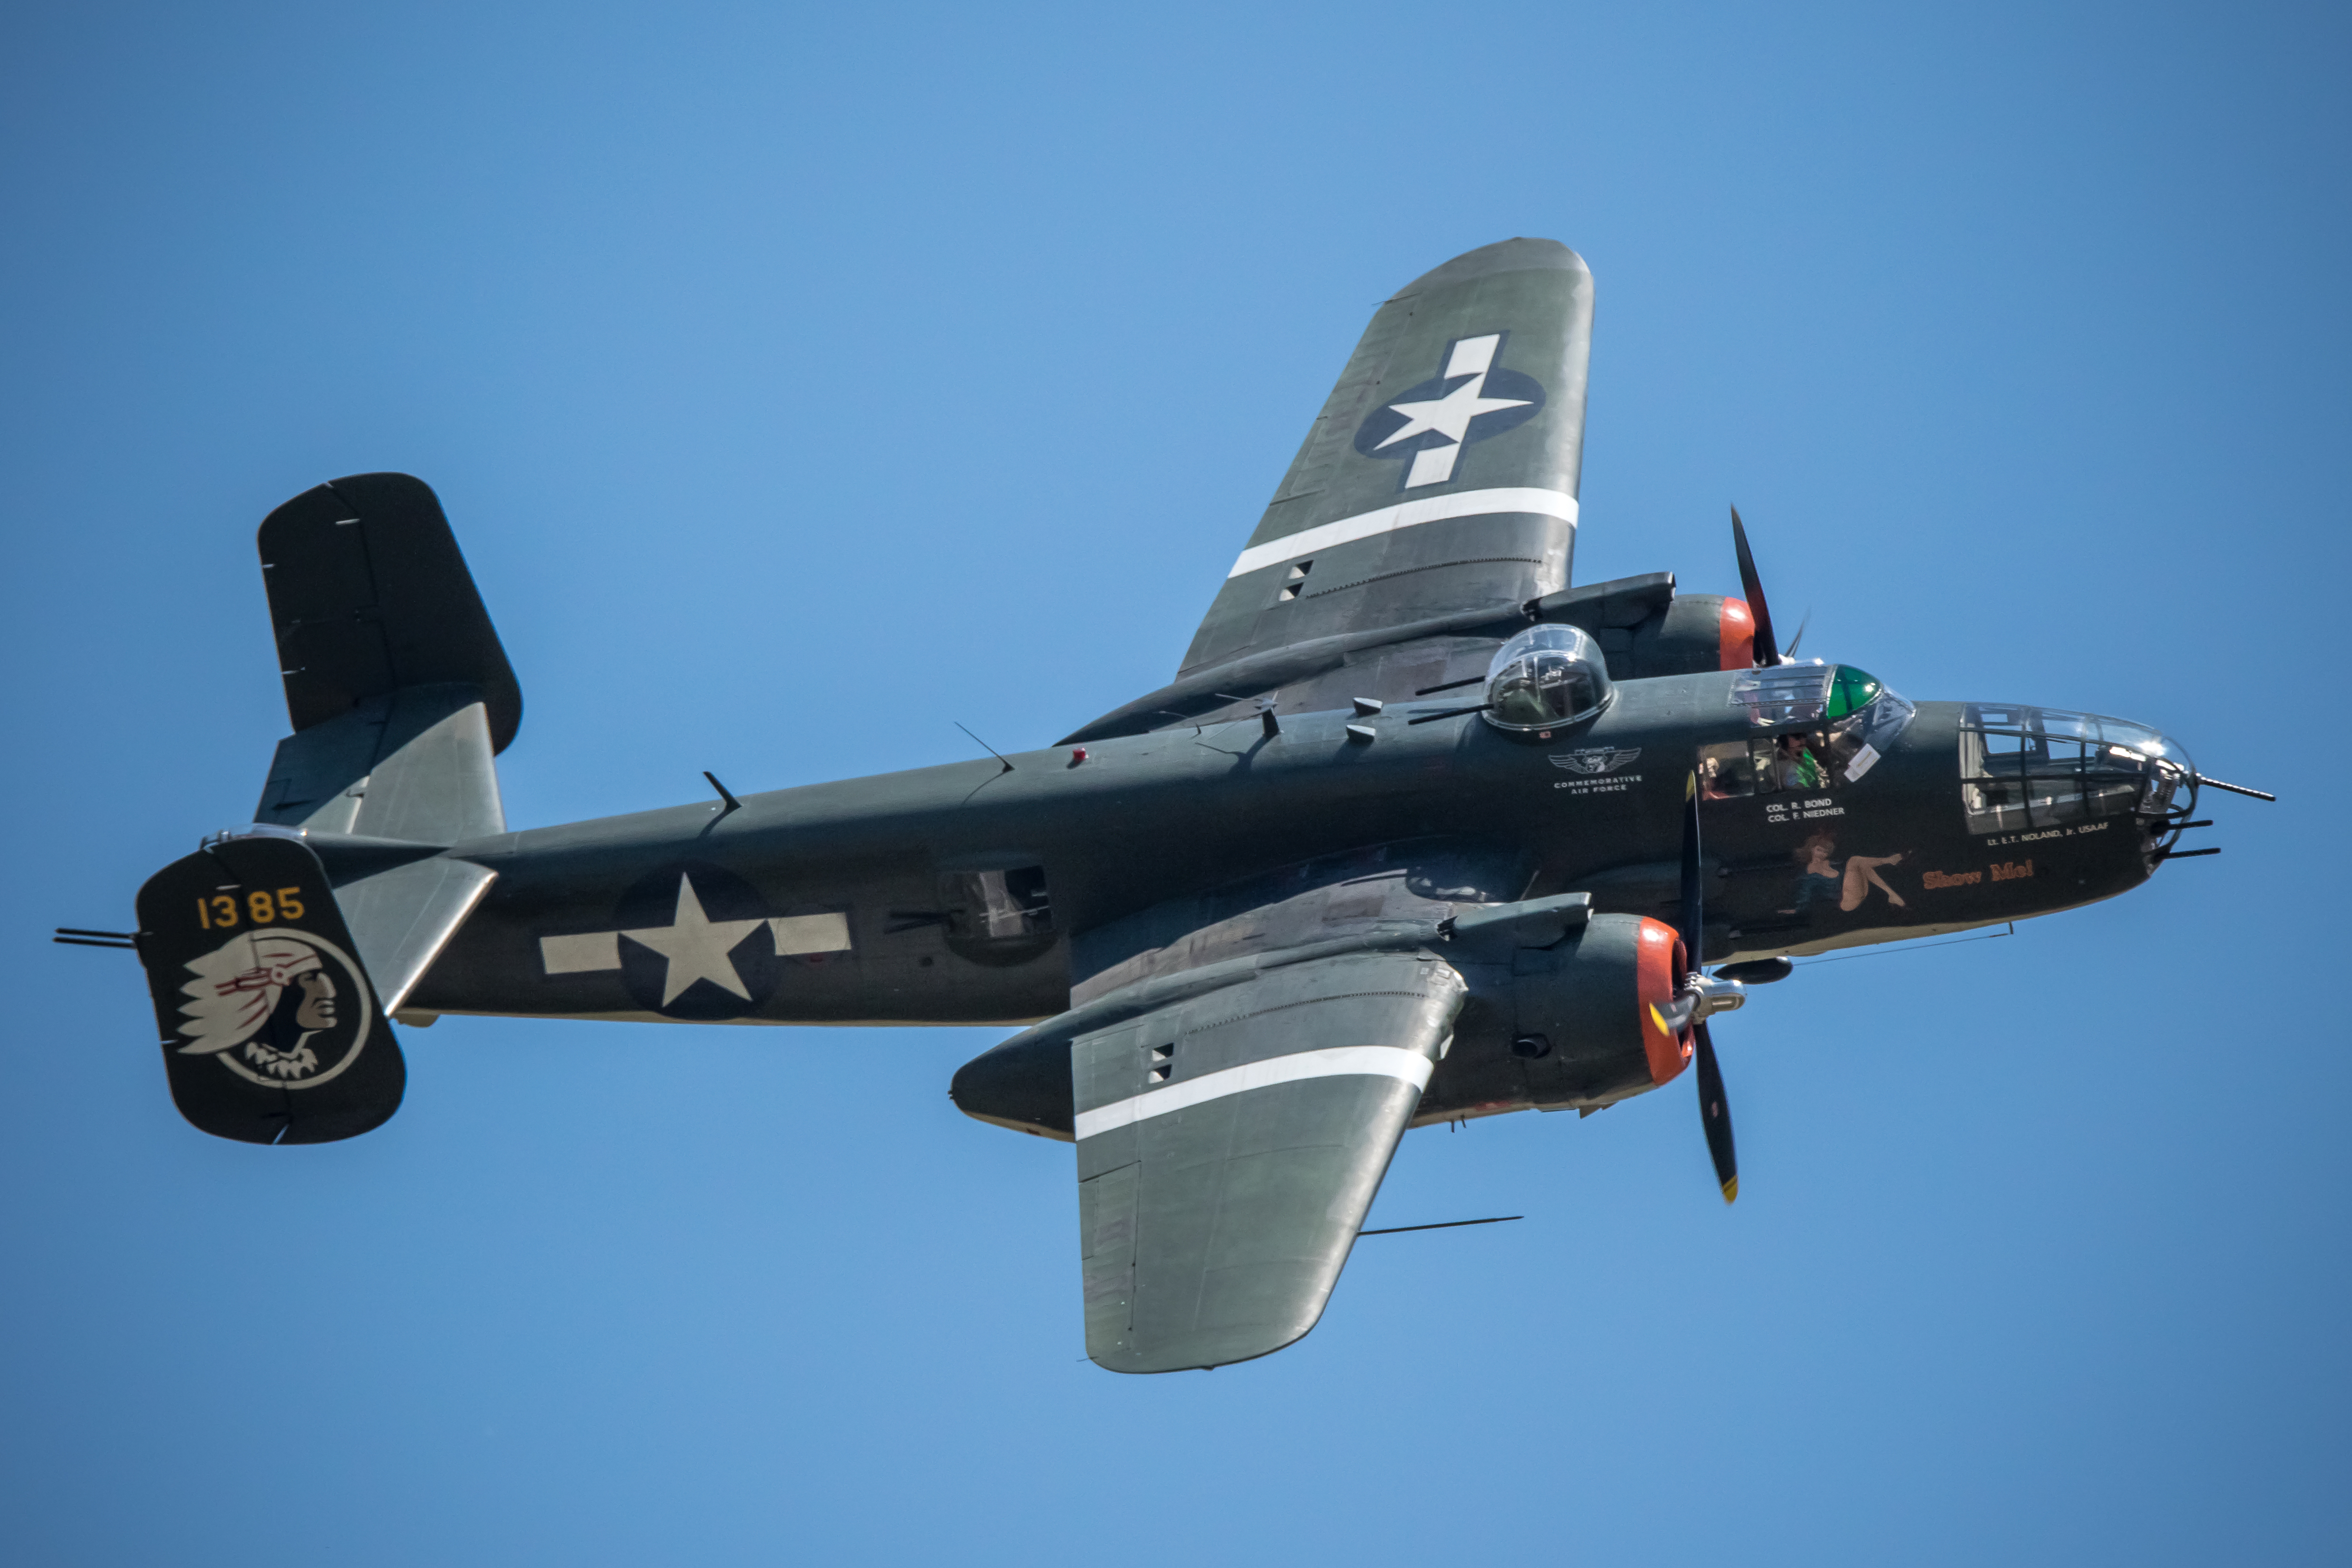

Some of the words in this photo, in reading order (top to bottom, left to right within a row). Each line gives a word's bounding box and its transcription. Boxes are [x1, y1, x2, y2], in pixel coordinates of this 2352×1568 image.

[1554, 775, 1642, 788] COMMEMORATIVE
[1593, 784, 1627, 793] FORCE
[1804, 798, 1832, 808] BOND
[1803, 807, 1845, 818] NIEDNER
[1923, 871, 1982, 889] Show
[1990, 859, 2033, 881] Me!
[197, 886, 305, 929] 1385
